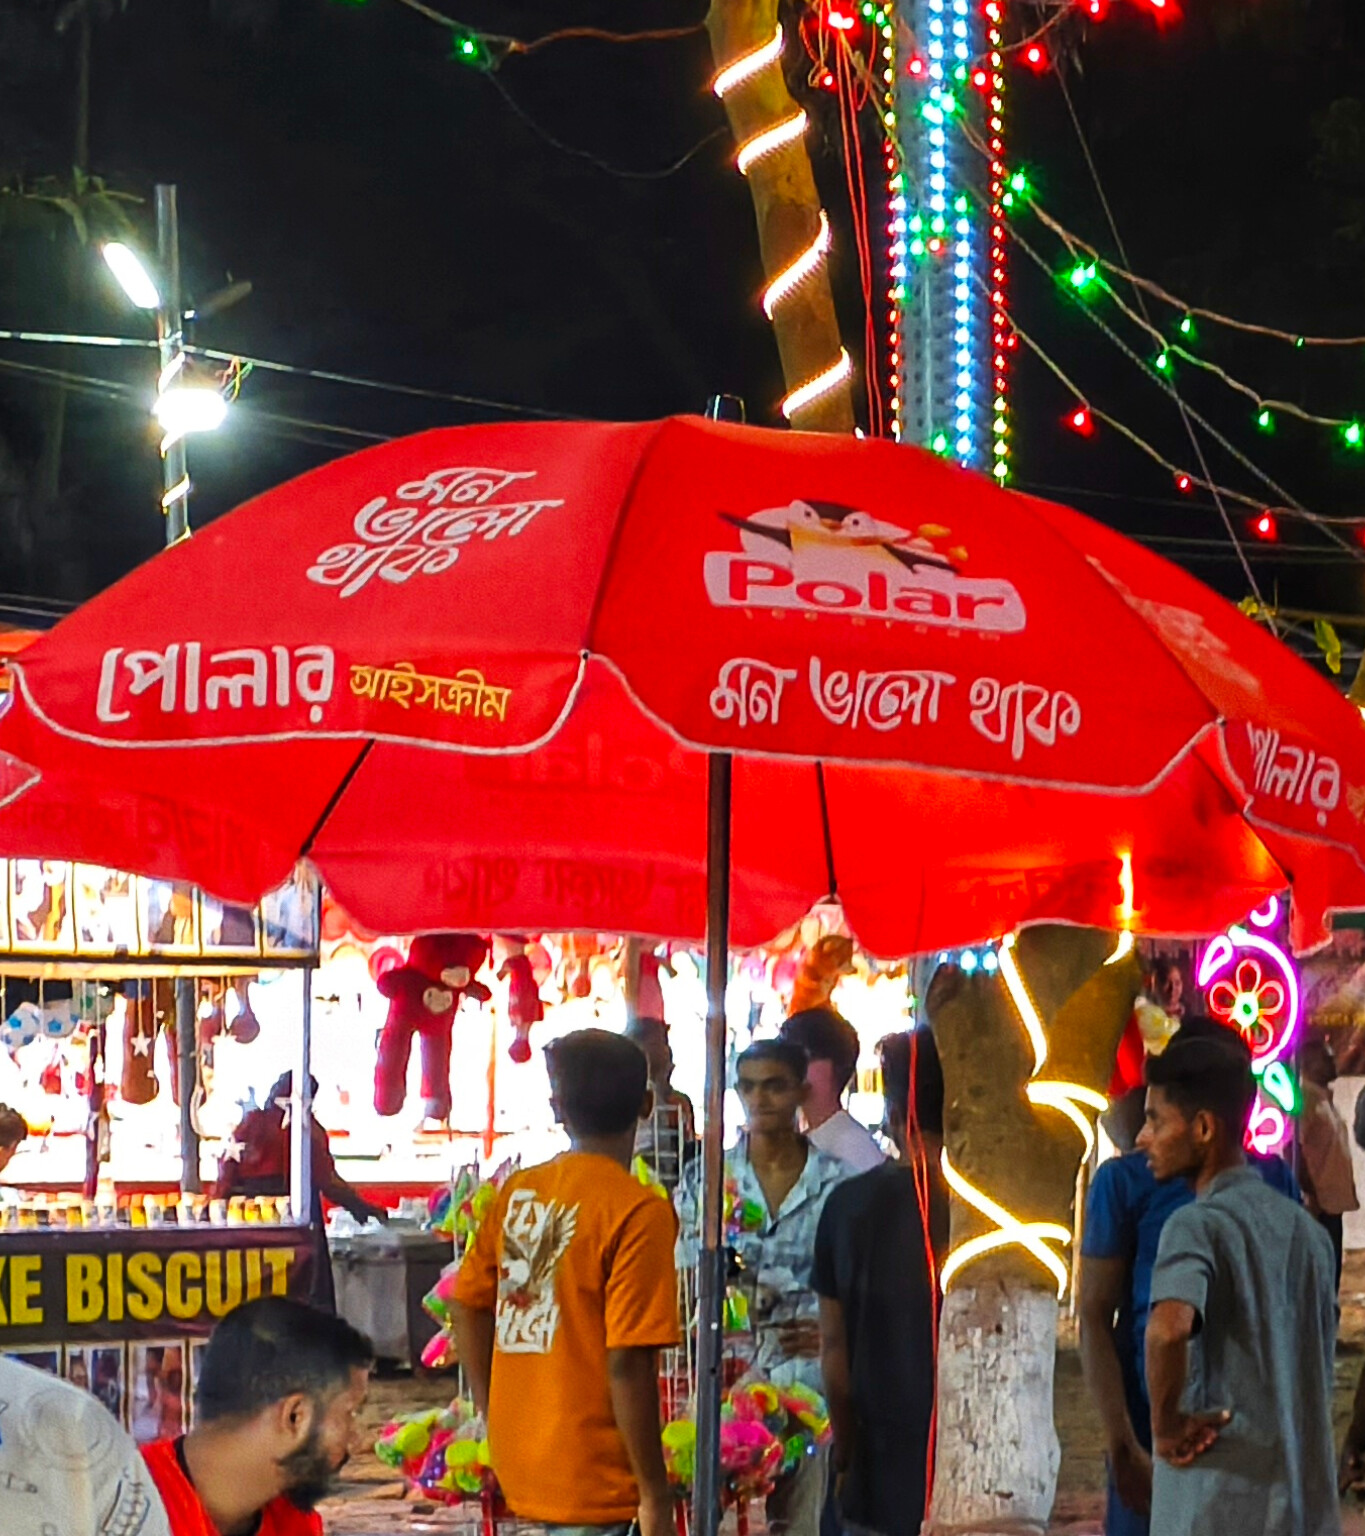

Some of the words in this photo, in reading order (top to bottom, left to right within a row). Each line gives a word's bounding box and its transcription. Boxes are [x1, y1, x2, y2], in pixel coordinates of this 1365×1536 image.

[728, 558, 1006, 622] Polar
[94, 641, 336, 725] পোলার
[348, 662, 513, 723] আইসক্রীম
[709, 656, 798, 729] মন
[808, 654, 955, 732] ভালো
[66, 1247, 296, 1322] BISCUIT
